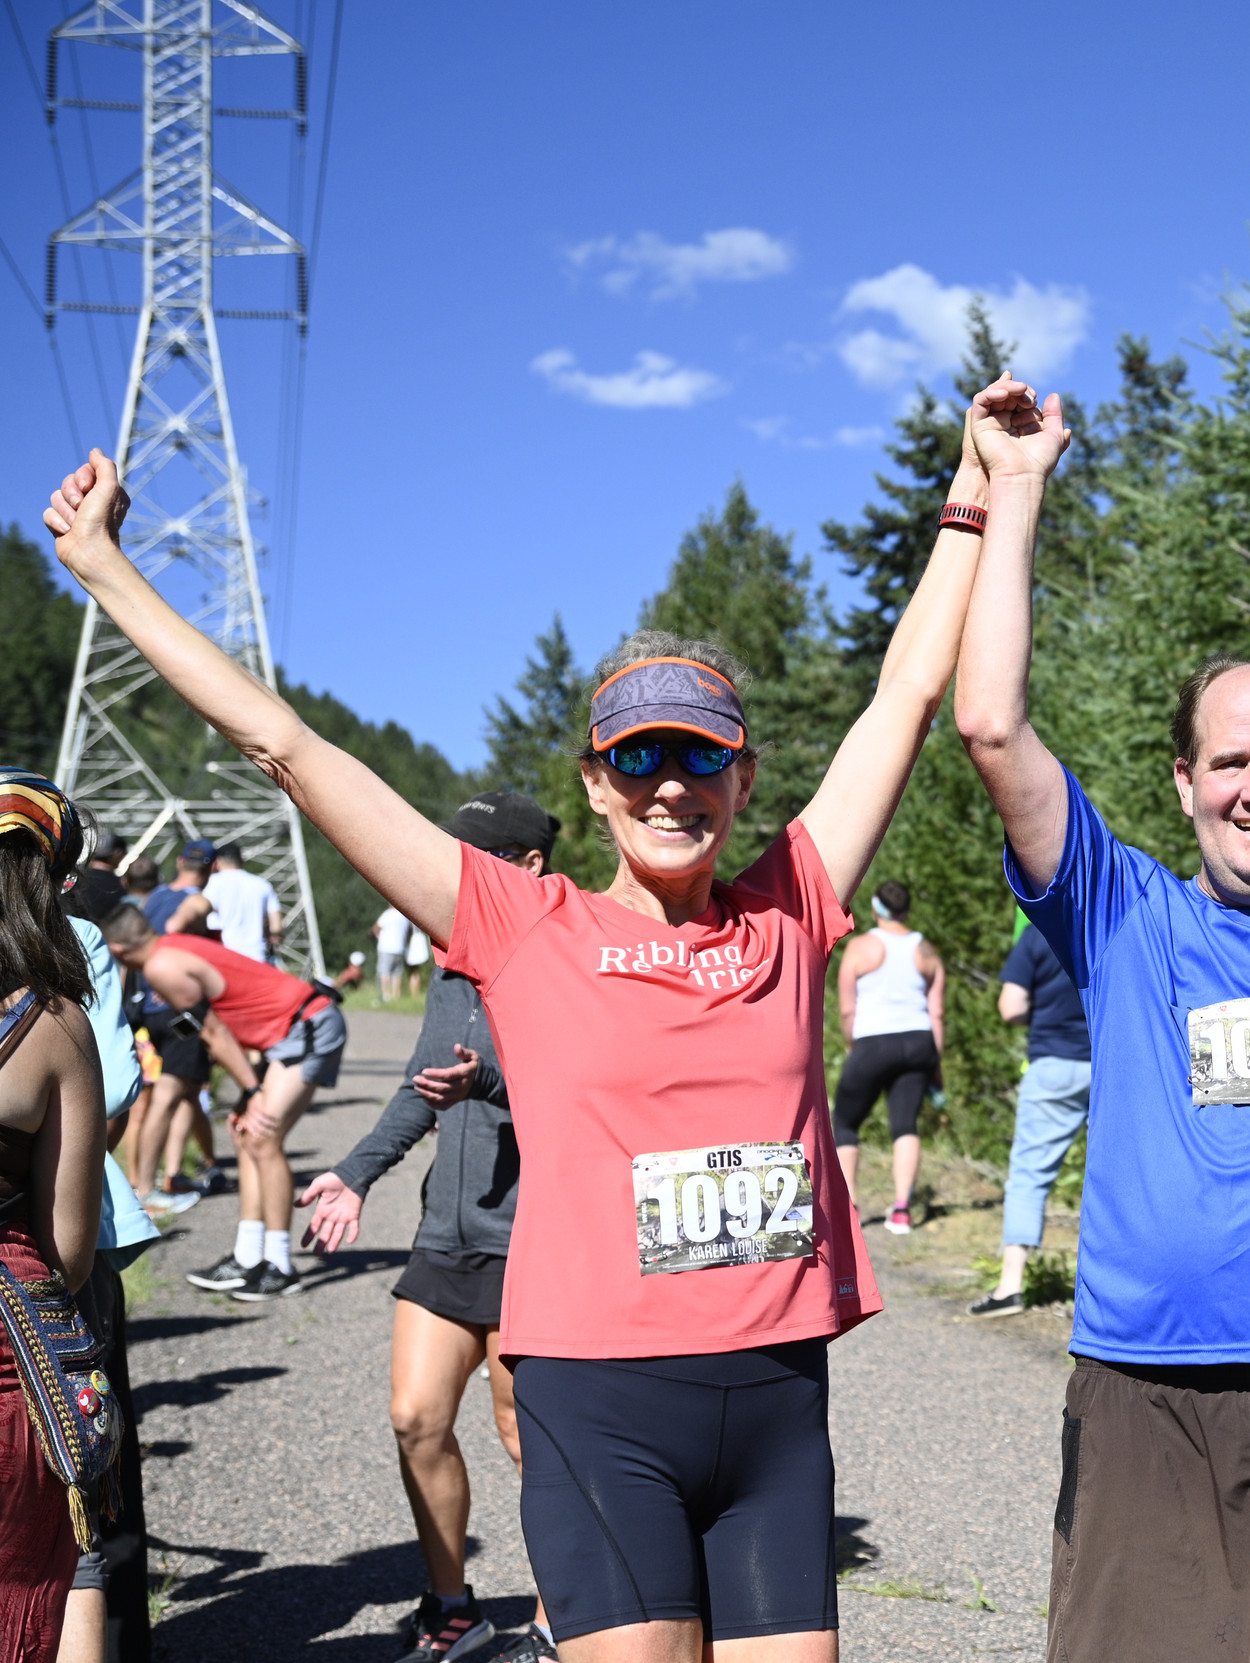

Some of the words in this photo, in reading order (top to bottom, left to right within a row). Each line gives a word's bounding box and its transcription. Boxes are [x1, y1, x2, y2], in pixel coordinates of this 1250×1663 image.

[706, 1149, 742, 1169] GTIS
[647, 1167, 799, 1245] 1092
[688, 1243, 728, 1261] KAREN
[732, 1238, 768, 1257] LOUISE
